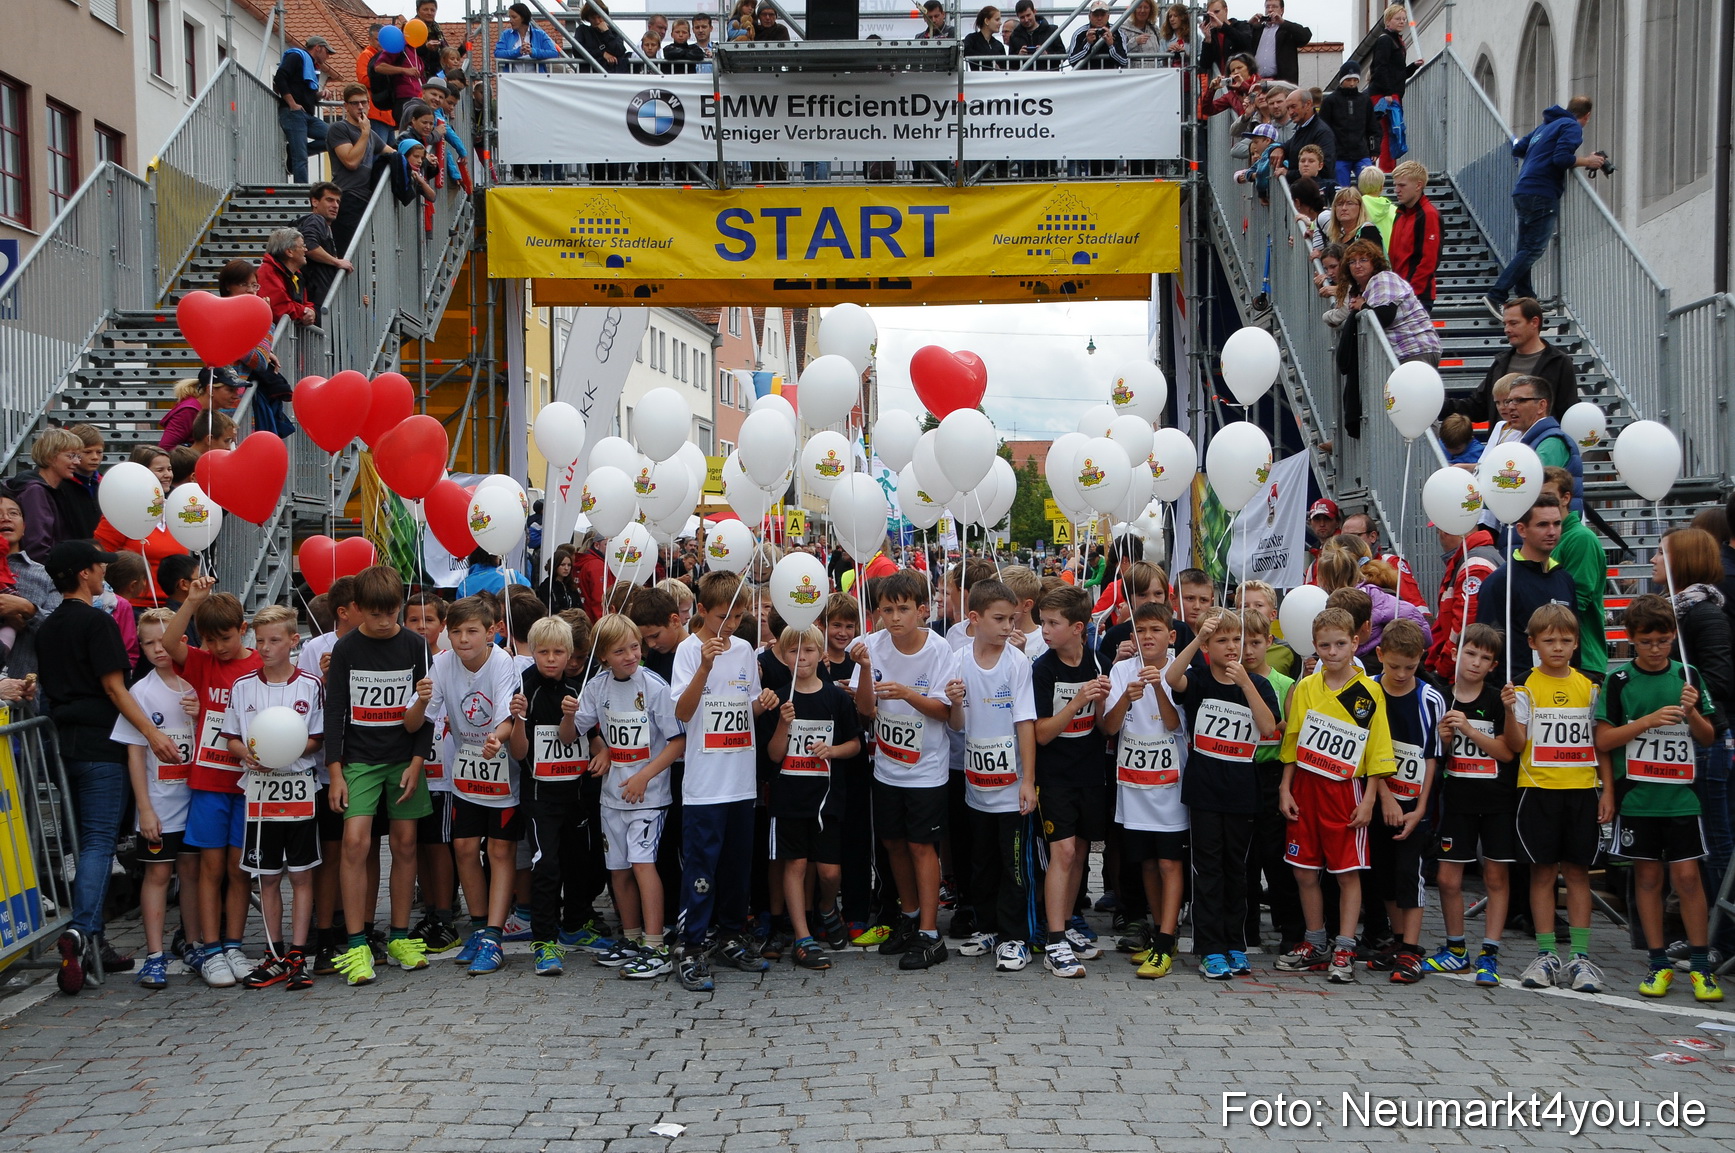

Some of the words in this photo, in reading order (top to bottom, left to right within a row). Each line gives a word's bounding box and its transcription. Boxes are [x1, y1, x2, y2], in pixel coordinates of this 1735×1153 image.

[632, 89, 681, 109] BMW
[701, 94, 779, 118] BMW
[787, 92, 1053, 122] EfficientDynamics
[701, 124, 780, 143] Weniger
[784, 123, 887, 140] Verbrauch.
[893, 123, 942, 139] Mehr
[947, 122, 1055, 139] Fahrfreude.
[714, 206, 950, 262] START
[992, 232, 1073, 248] Neumarkter
[1077, 231, 1140, 247] Stadtlauf
[525, 235, 605, 250] Neumarkter
[608, 235, 674, 250] Stadtlauf
[790, 518, 800, 531] A
[1058, 525, 1068, 538] A
[357, 686, 407, 706] 7207
[1056, 687, 1077, 695] PARTL
[362, 709, 402, 720] Jonathan
[1201, 703, 1224, 713] PARTL
[1224, 708, 1251, 718] Neumarkt
[207, 716, 224, 724] PART
[884, 717, 913, 727] Neumarkt
[1306, 714, 1326, 728] PARTL
[1327, 722, 1357, 738] Neumarkt
[1205, 714, 1252, 742] 7211
[1541, 722, 1590, 744] 7084
[1654, 729, 1686, 737] Neumarkt
[723, 735, 744, 746] Jonas
[975, 742, 1003, 750] Neumarkt
[1212, 742, 1239, 754] Jonas
[1306, 725, 1357, 761] 7080
[1554, 750, 1581, 760] Jonas
[1635, 737, 1688, 762] 7153
[790, 759, 816, 769] Jakob
[1124, 747, 1172, 769] 7378
[1304, 751, 1342, 775] Matthias
[458, 758, 501, 781] 7187
[551, 764, 577, 774] Fabian
[1644, 764, 1678, 776] Maxim
[255, 780, 307, 801] 7293
[468, 782, 494, 793] Patrick
